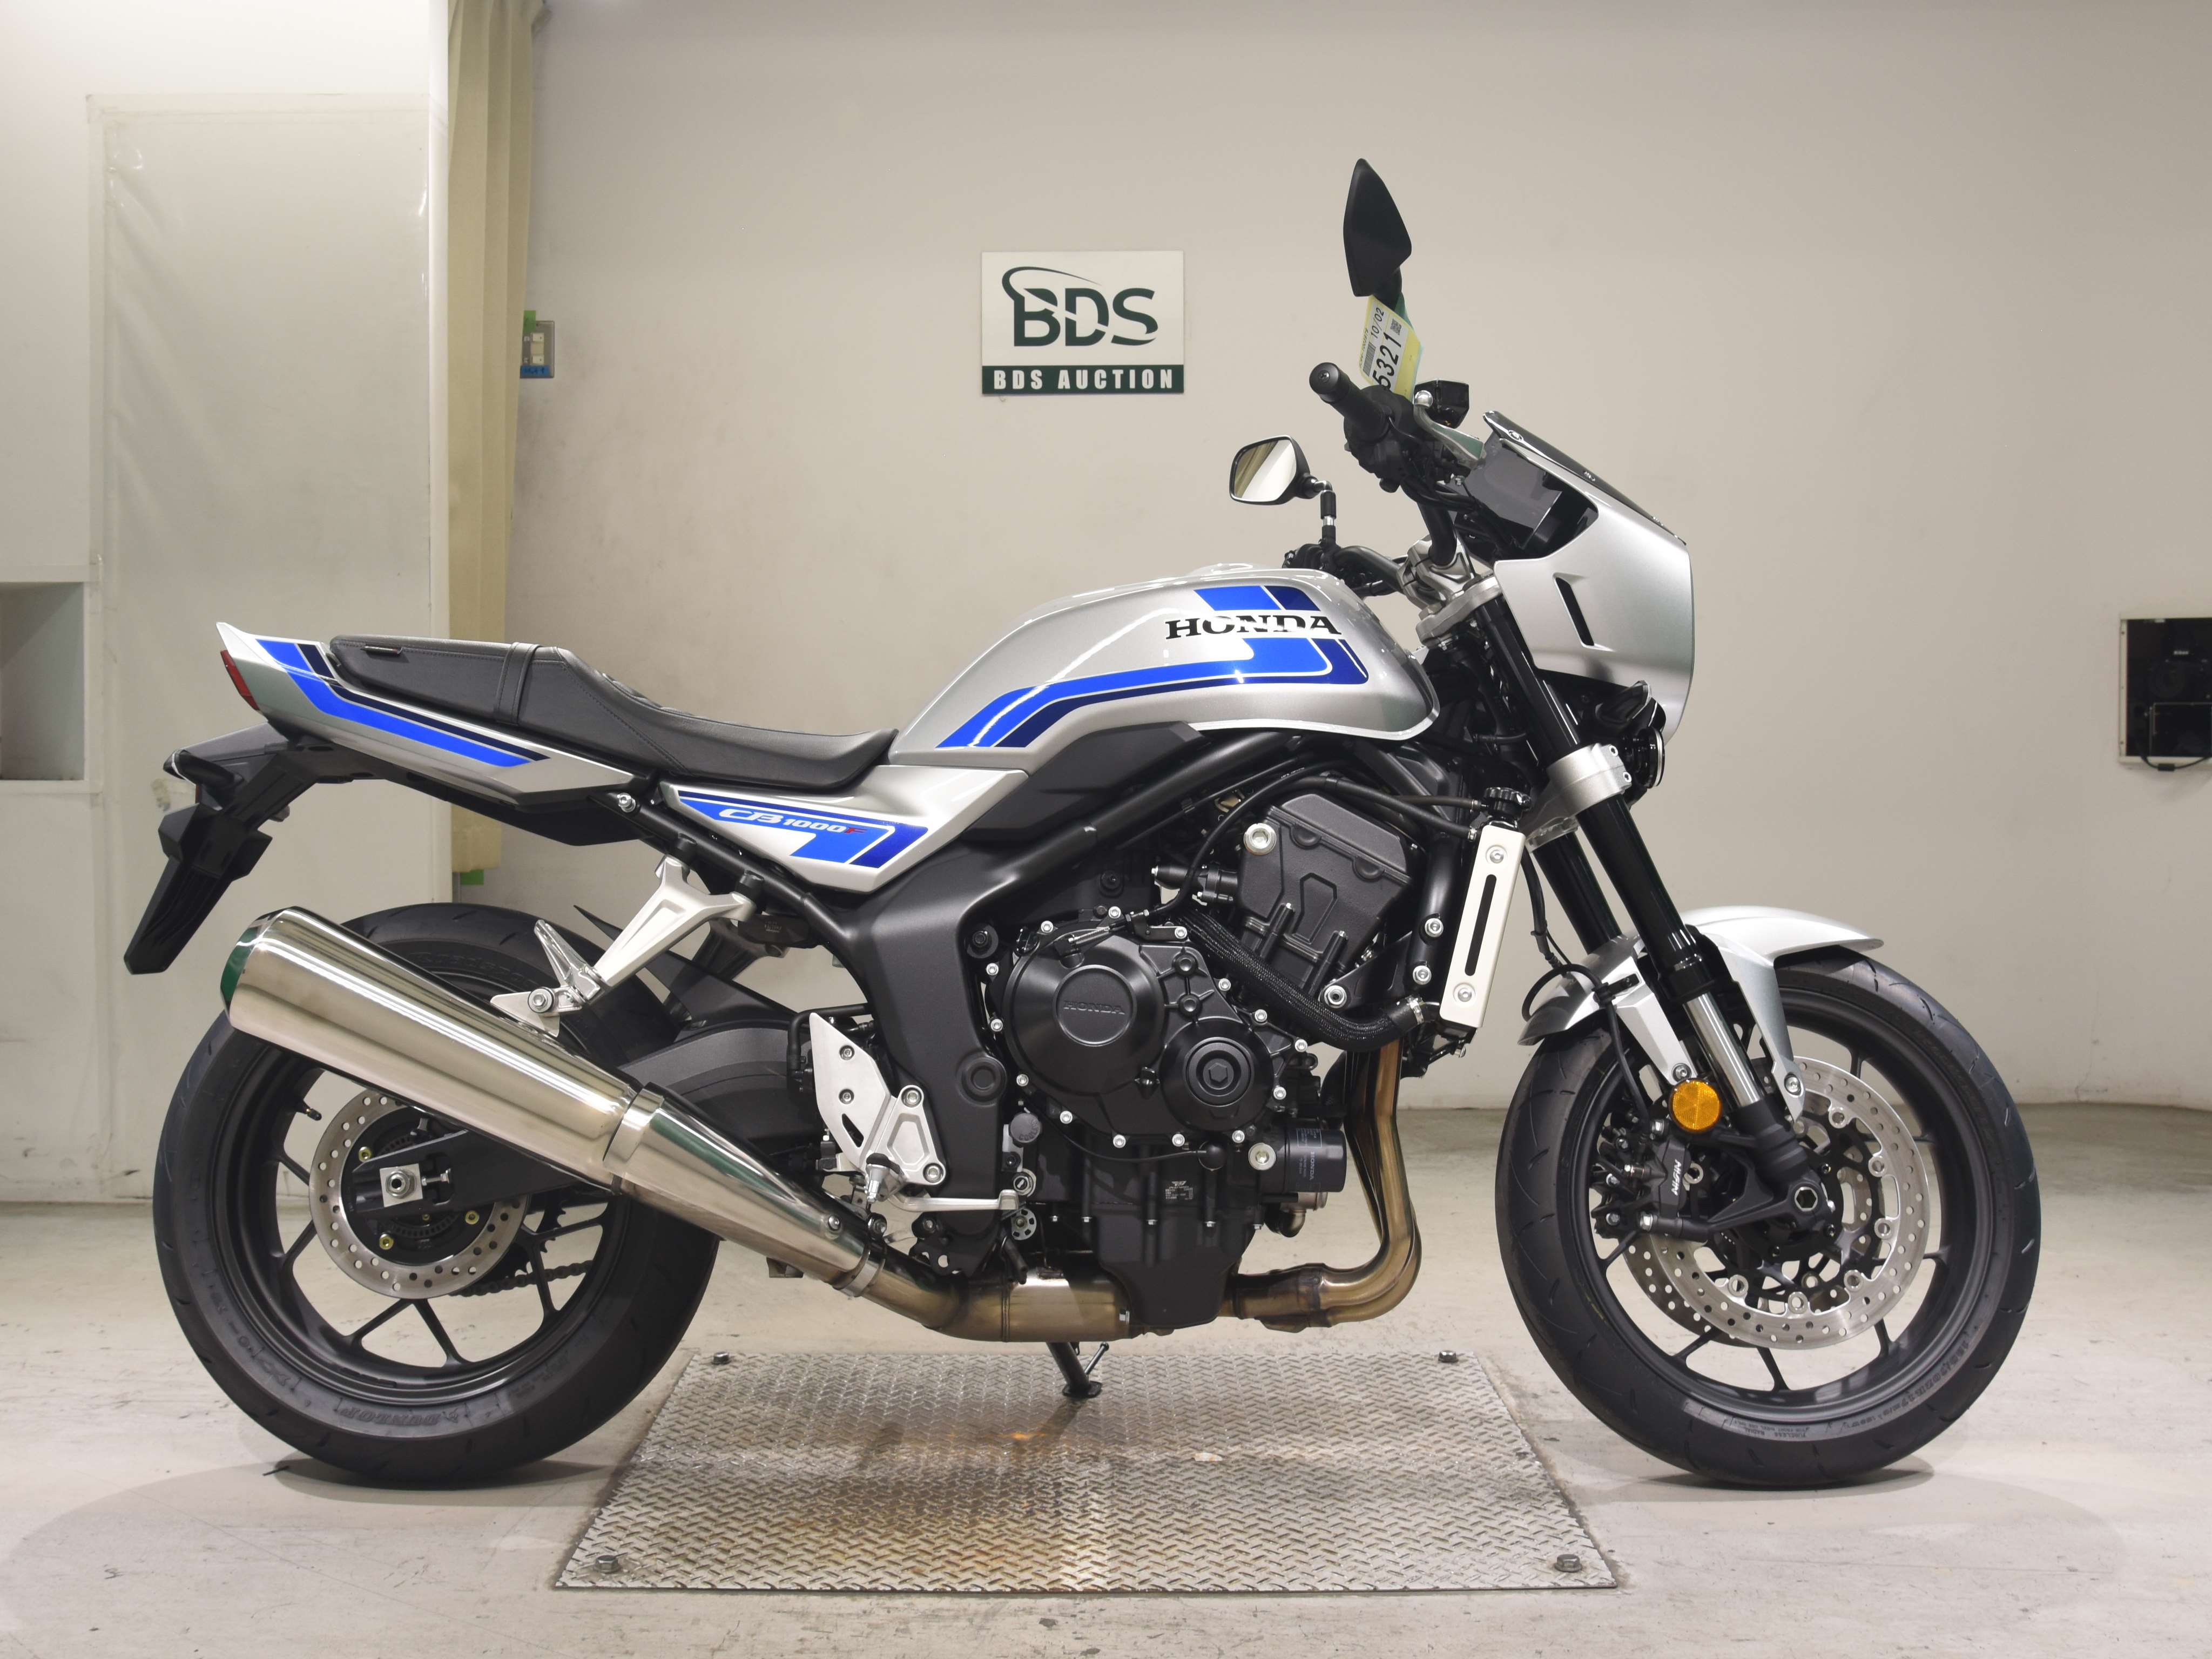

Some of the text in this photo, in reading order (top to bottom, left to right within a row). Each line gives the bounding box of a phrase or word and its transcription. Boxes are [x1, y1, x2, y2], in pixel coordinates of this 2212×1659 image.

[1002, 266, 1158, 346] BDS
[1370, 307, 1384, 339] 10/02
[993, 369, 1173, 389] BDS AUCTION
[1164, 615, 1342, 640] HONDA
[1063, 1000, 1125, 1015] HONDA
[1671, 1159, 1682, 1196] NISSIN
